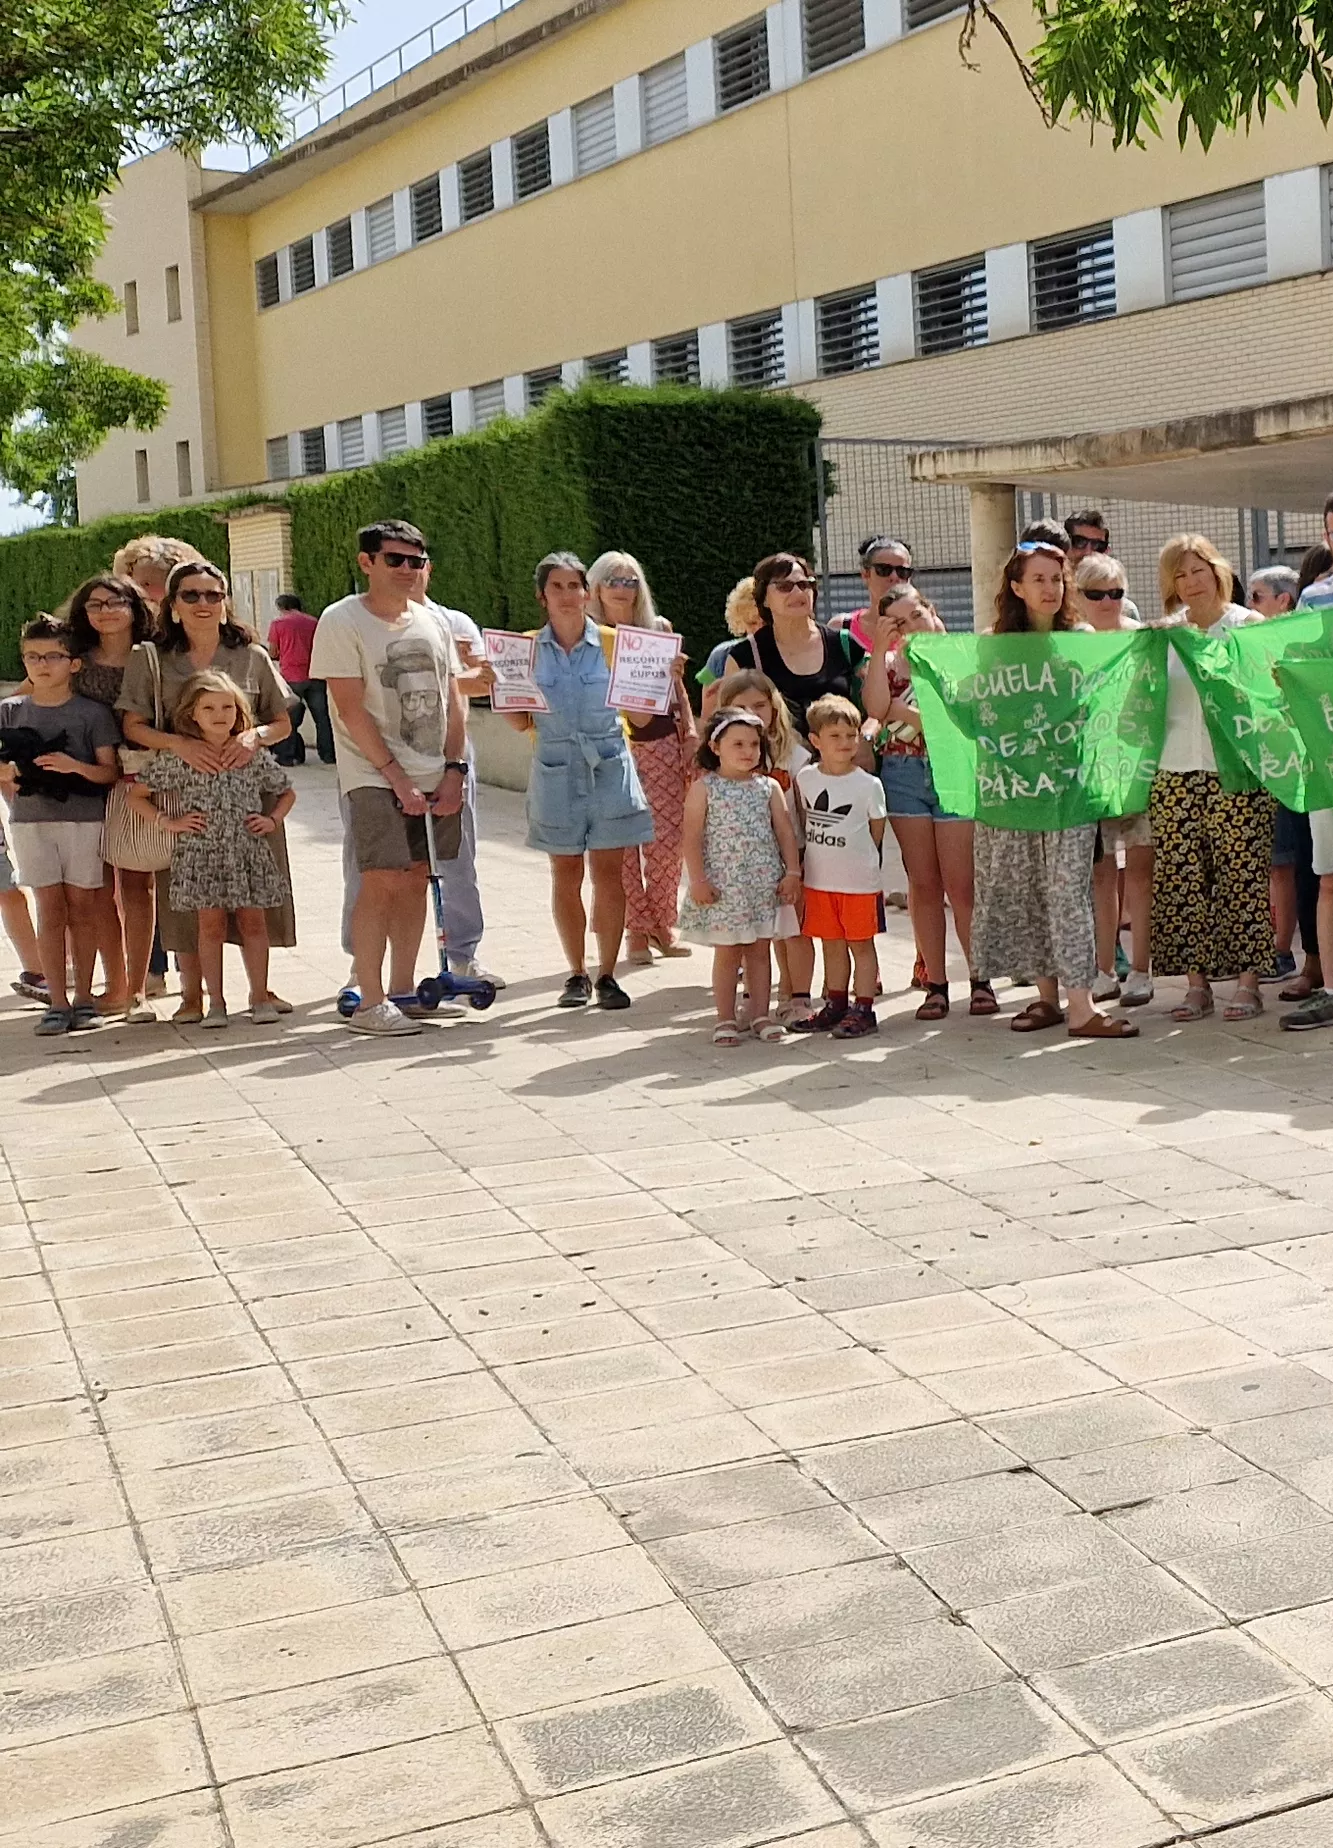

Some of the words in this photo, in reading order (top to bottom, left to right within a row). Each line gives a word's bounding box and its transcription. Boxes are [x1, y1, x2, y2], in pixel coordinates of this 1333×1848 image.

[487, 636, 505, 654] NO
[620, 631, 643, 651] NO
[979, 732, 1018, 758] DE
[977, 770, 1056, 801] PARA
[804, 828, 847, 848] didas
